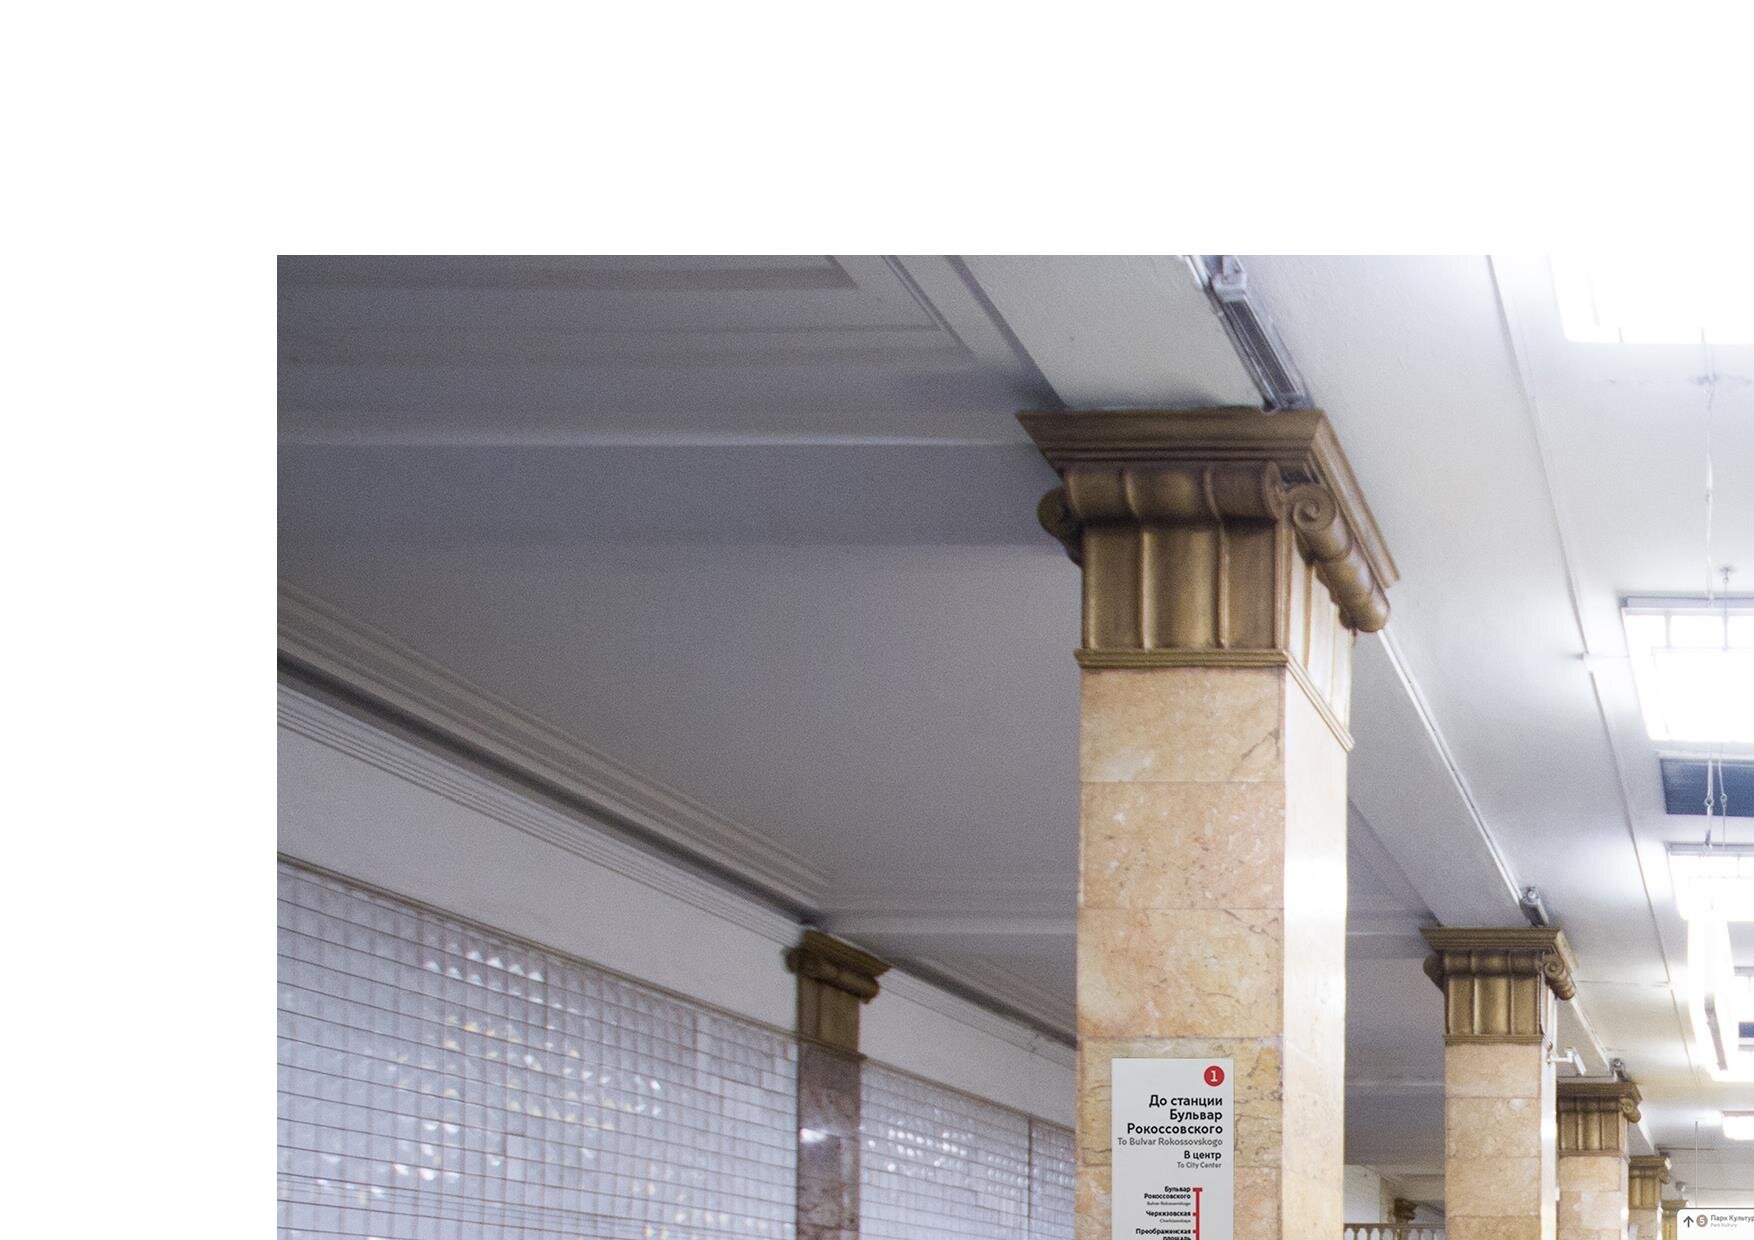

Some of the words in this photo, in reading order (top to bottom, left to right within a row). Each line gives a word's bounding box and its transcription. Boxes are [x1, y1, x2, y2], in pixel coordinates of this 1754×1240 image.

[1148, 1094, 1168, 1108] До
[1170, 1098, 1223, 1108] станции
[1169, 1109, 1223, 1122] Бульвар
[1127, 1122, 1223, 1134] Рокоссовского
[1117, 1137, 1127, 1146] To
[1129, 1137, 1156, 1146] Bulvar
[1158, 1137, 1223, 1147] Rokossovskogo
[1184, 1151, 1191, 1159] В
[1193, 1151, 1222, 1161] центр
[1177, 1161, 1185, 1169] To
[1186, 1161, 1199, 1169] City
[1200, 1161, 1222, 1169] Center
[1710, 1214, 1728, 1222] Парк
